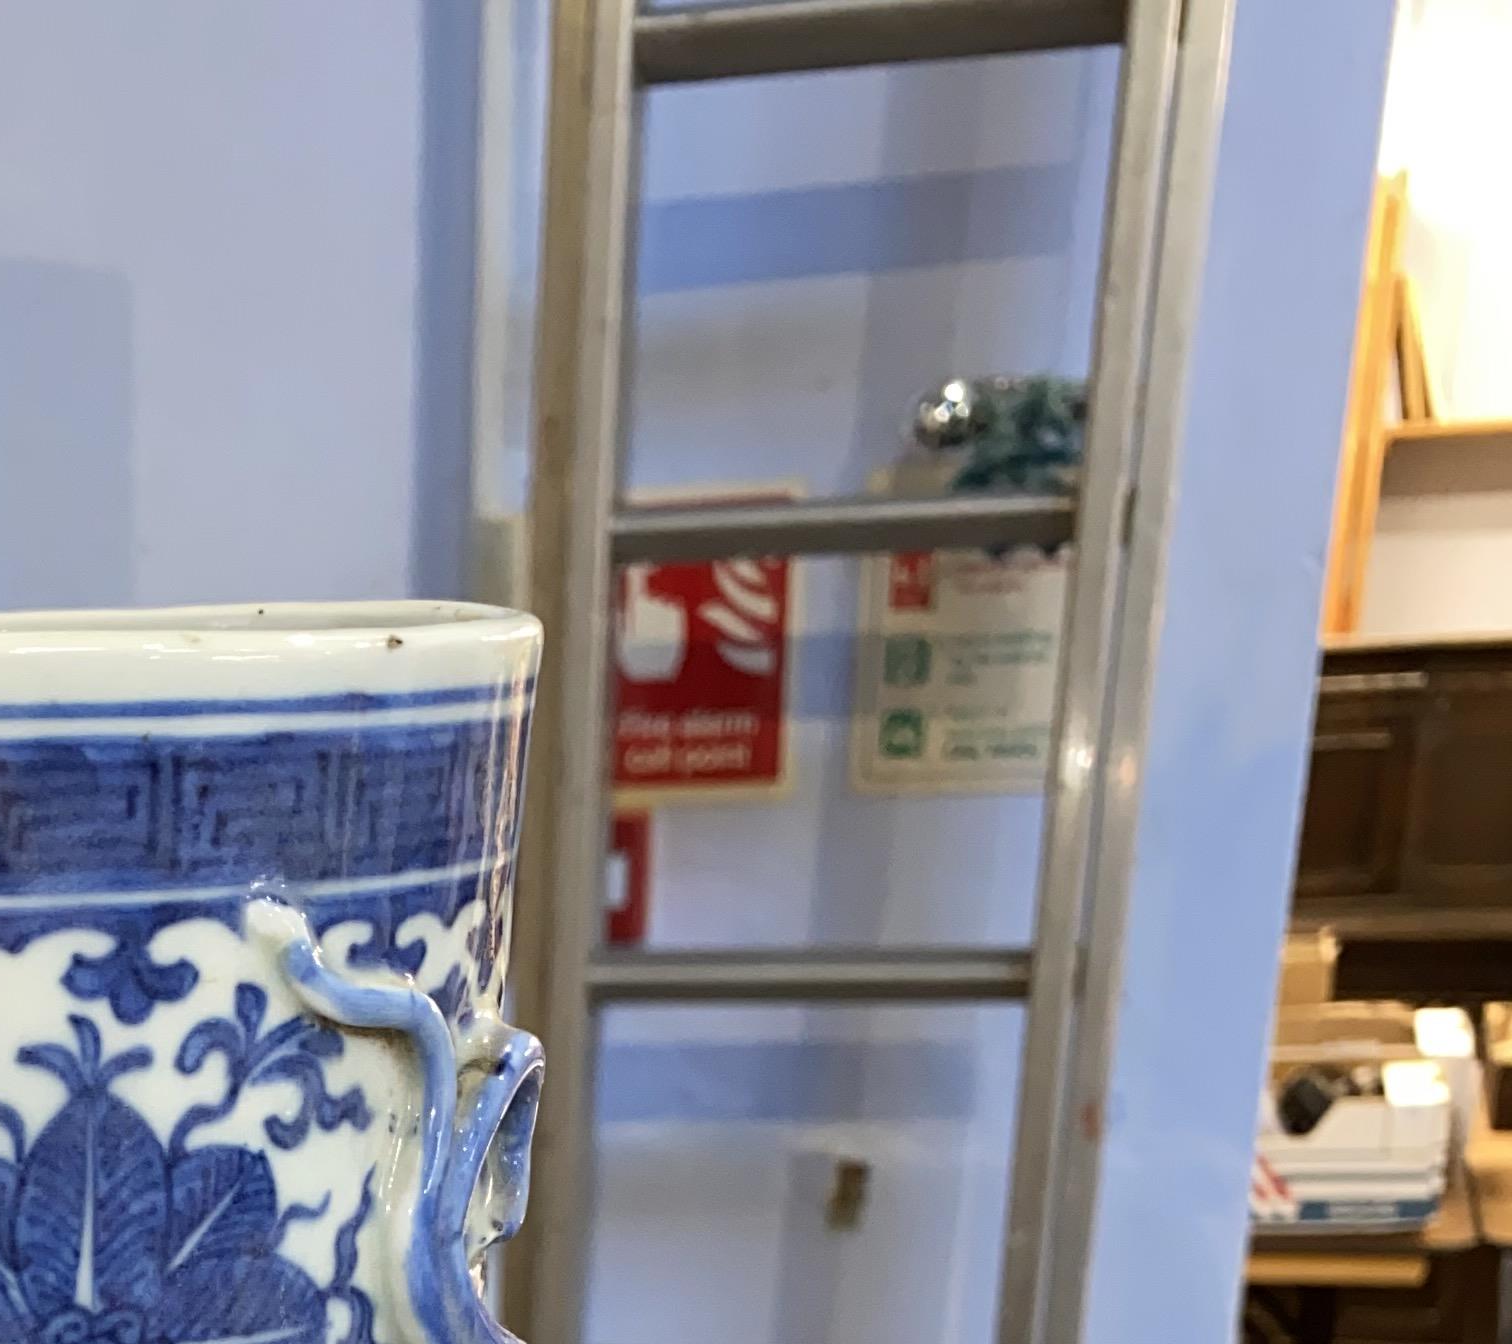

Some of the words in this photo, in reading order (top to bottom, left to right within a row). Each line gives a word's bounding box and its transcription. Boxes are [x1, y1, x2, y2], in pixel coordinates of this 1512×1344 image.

[682, 708, 759, 737] alarm
[624, 746, 671, 772] call
[681, 745, 751, 776] point
